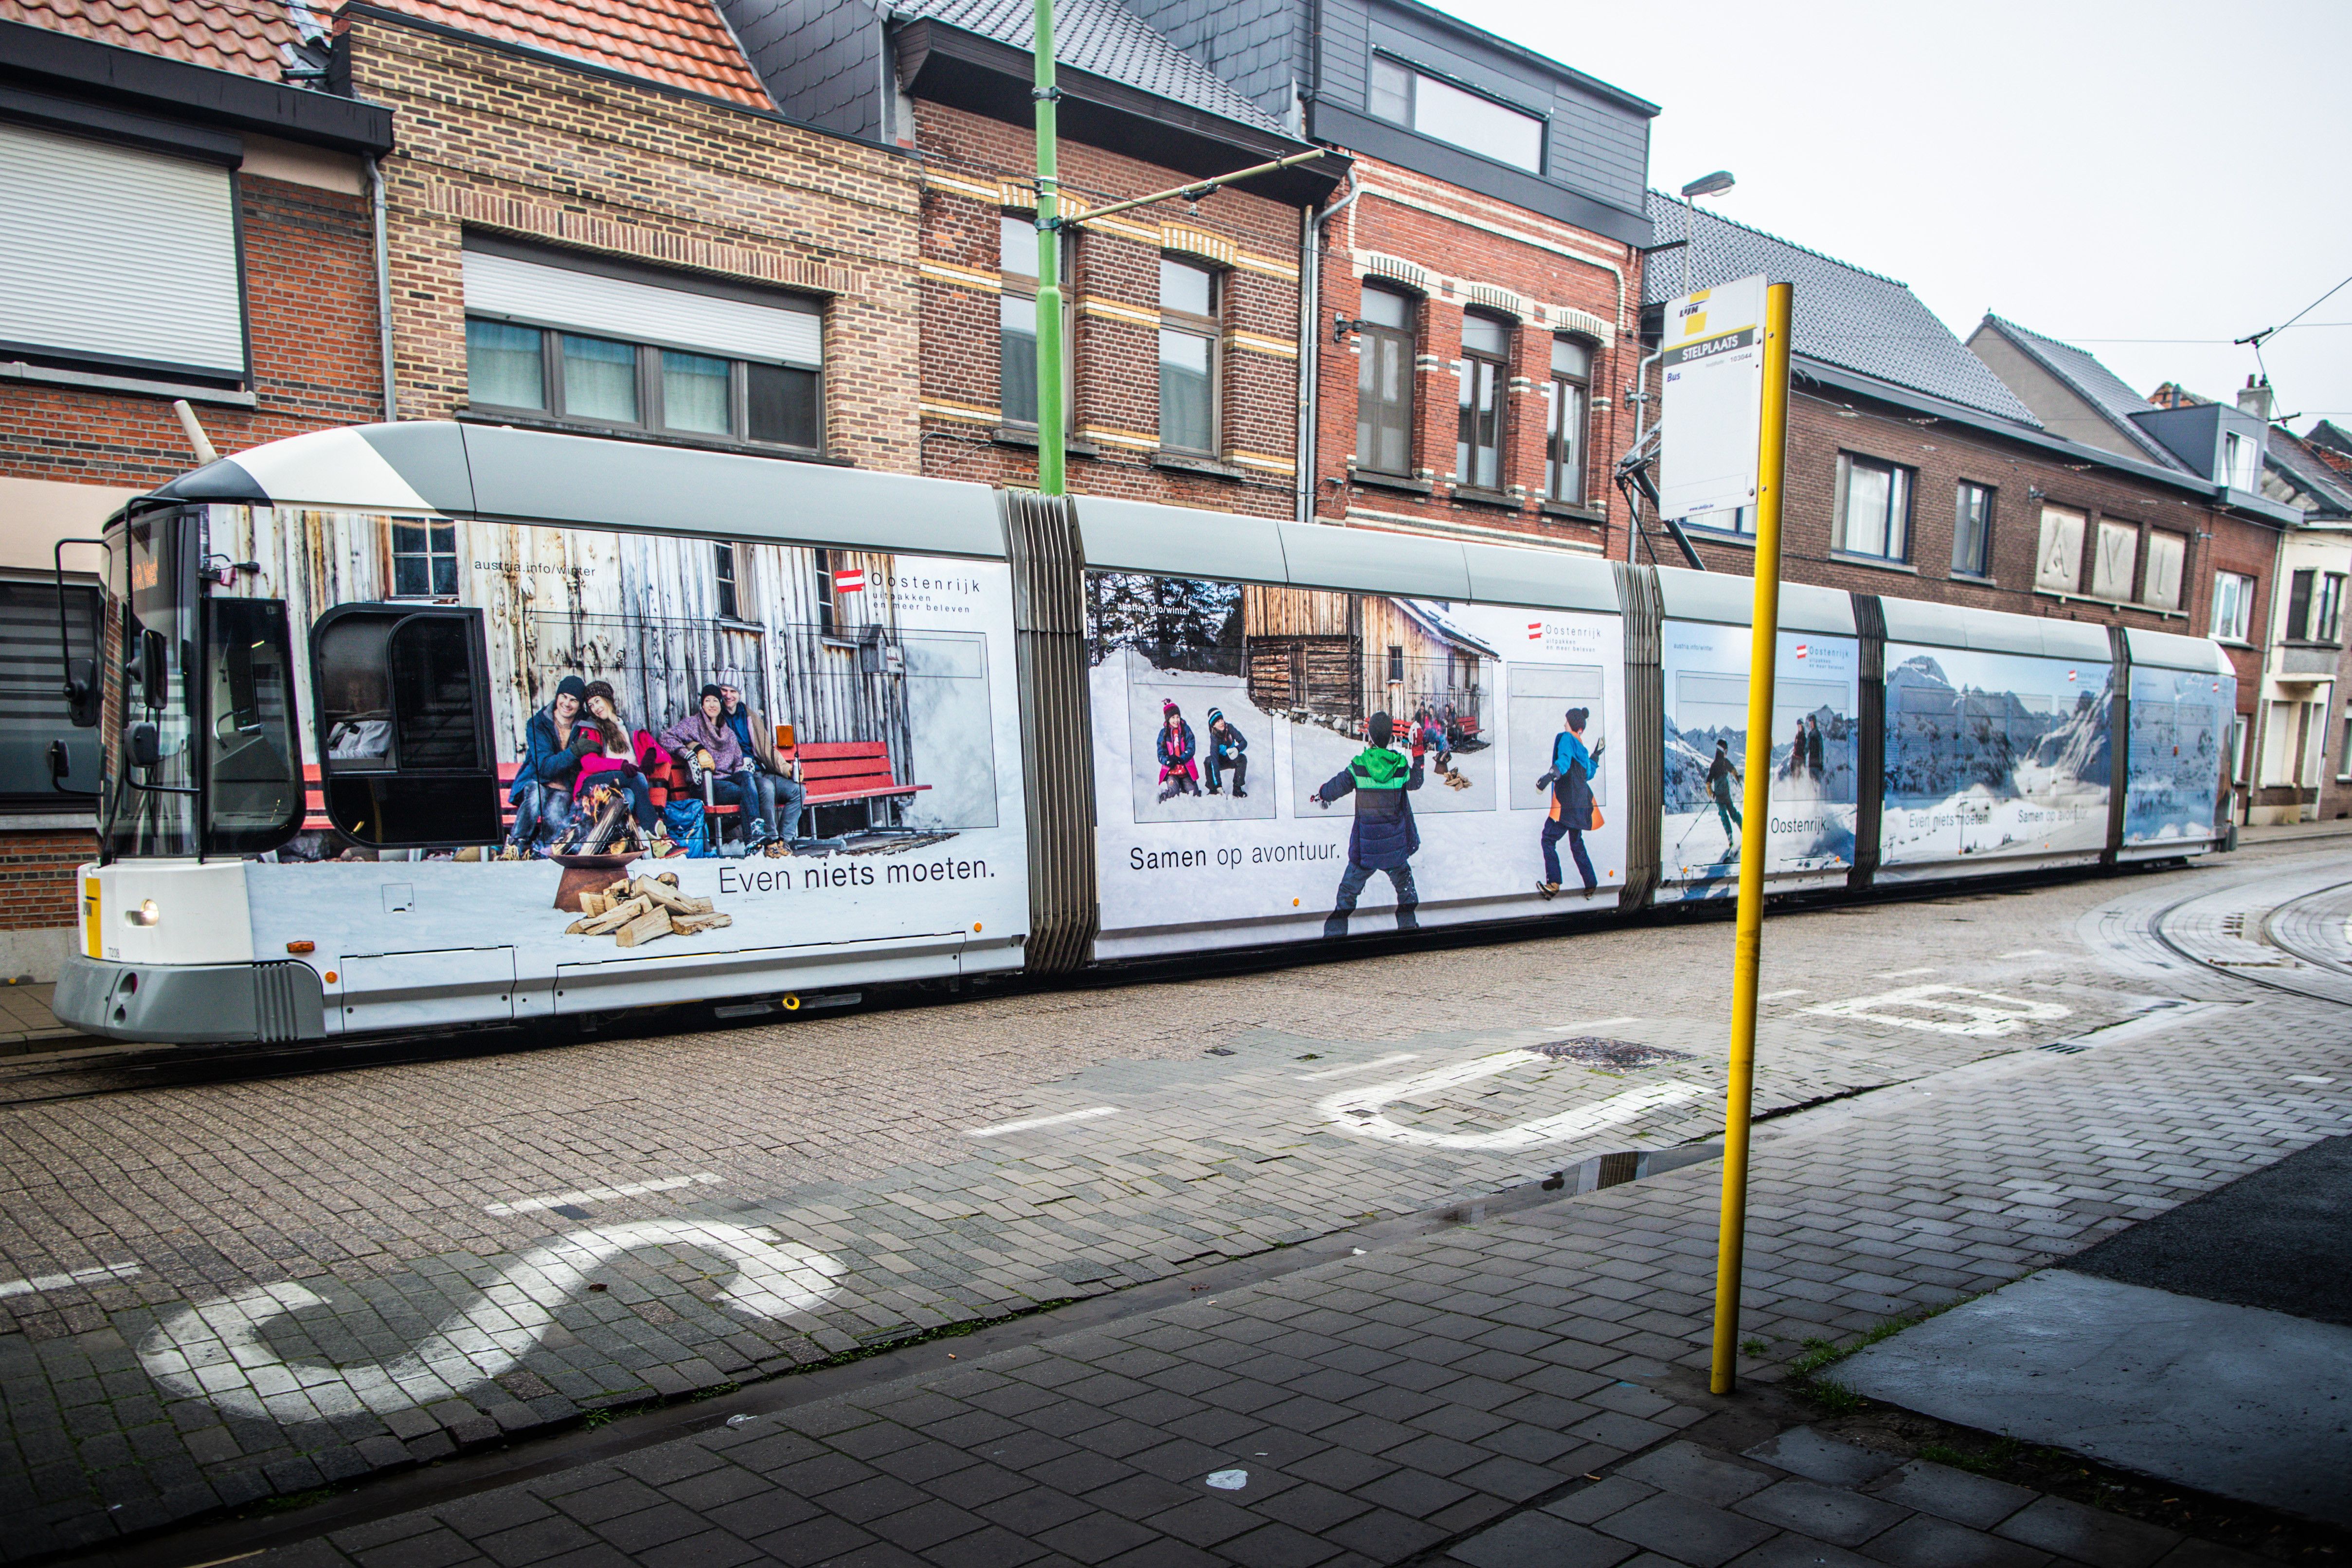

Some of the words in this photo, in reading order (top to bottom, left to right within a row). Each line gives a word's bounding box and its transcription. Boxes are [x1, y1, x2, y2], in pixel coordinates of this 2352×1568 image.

[1682, 335, 1738, 360] STELPLAATS
[1730, 353, 1752, 362] 103044
[1667, 373, 1680, 382] Bus
[475, 561, 595, 576] austria.info/winter
[872, 573, 980, 595] Oostenrijk
[873, 592, 930, 601] uitpakken
[927, 604, 970, 613] beleven
[1117, 603, 1191, 615] austria.info/winter
[1546, 625, 1601, 639] Oostenrijk
[1809, 646, 1849, 659] Oostenrijk
[1909, 813, 1930, 828] Even
[1933, 811, 1954, 827] niets
[2018, 809, 2043, 823] Samen
[1771, 816, 1830, 835] Oostenrijk.
[1130, 847, 1206, 870] Samen
[1217, 848, 1242, 869] op
[1252, 841, 1340, 864] avontuur.
[719, 866, 790, 893] Even
[805, 862, 875, 888] niets
[888, 857, 995, 883] moeten.
